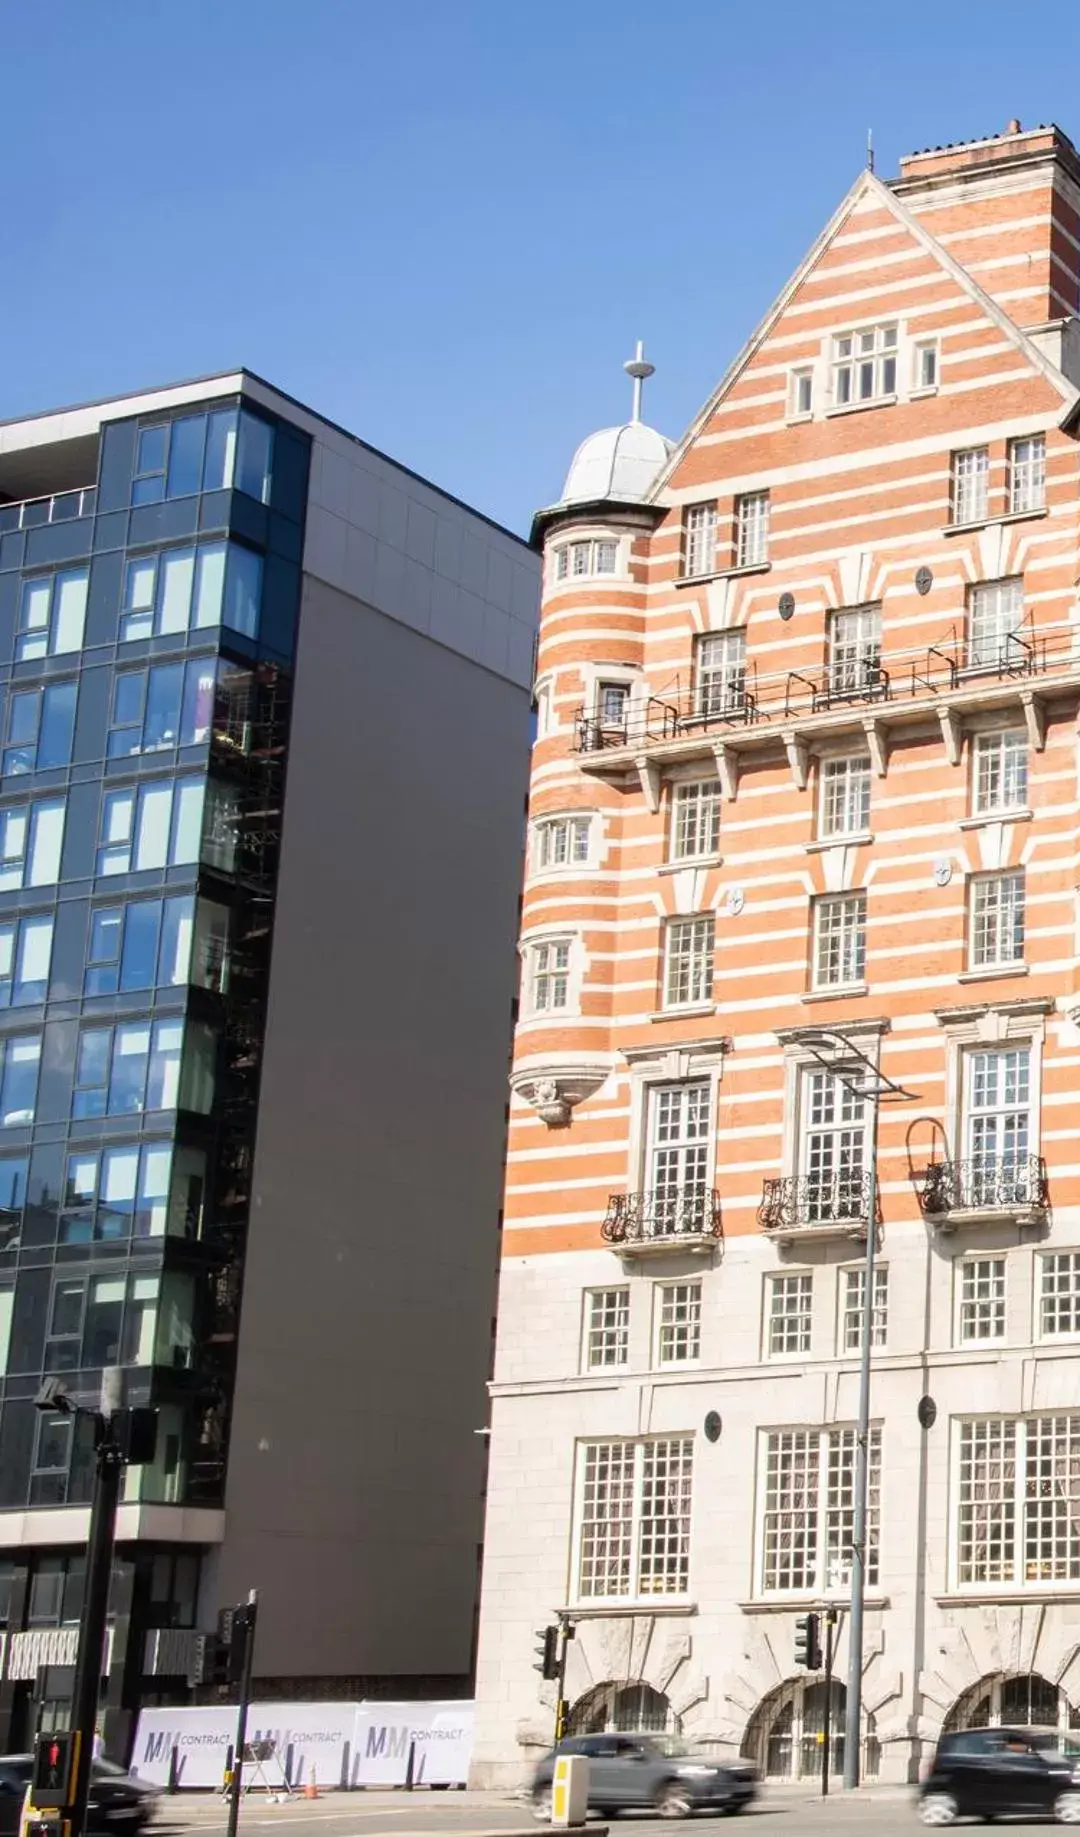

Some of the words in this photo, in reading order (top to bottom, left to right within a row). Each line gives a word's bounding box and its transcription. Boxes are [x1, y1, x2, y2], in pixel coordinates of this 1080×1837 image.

[144, 1731, 181, 1763] MM
[181, 1734, 230, 1745] CONTRACT
[293, 1731, 342, 1743] CONTRACT
[365, 1726, 409, 1758] MM
[410, 1728, 464, 1741] CONTRACT
